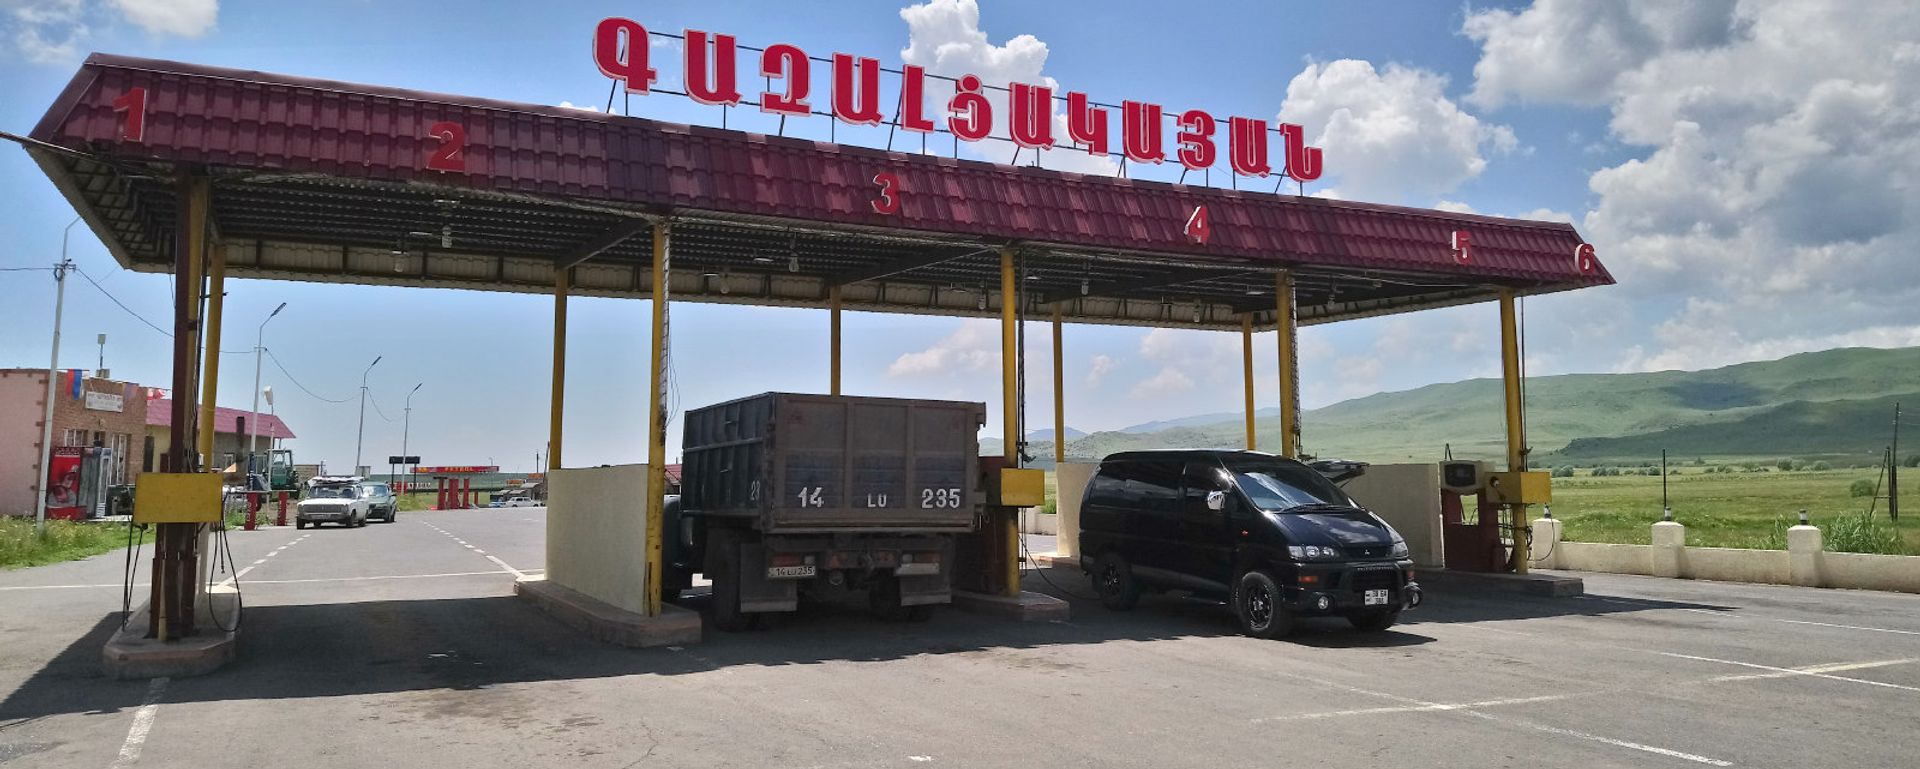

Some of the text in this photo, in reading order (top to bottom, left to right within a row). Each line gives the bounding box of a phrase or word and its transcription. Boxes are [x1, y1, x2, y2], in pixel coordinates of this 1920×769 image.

[112, 87, 147, 143] 1
[592, 16, 1323, 182] ԳԱԶԱԼՑԱԿԱՅԱՆ
[426, 121, 466, 173] 2
[870, 171, 899, 215] 3
[1184, 205, 1210, 245] 4
[1451, 230, 1473, 265] 5
[1574, 243, 1596, 276] 6
[797, 486, 962, 509] 14 LU 235
